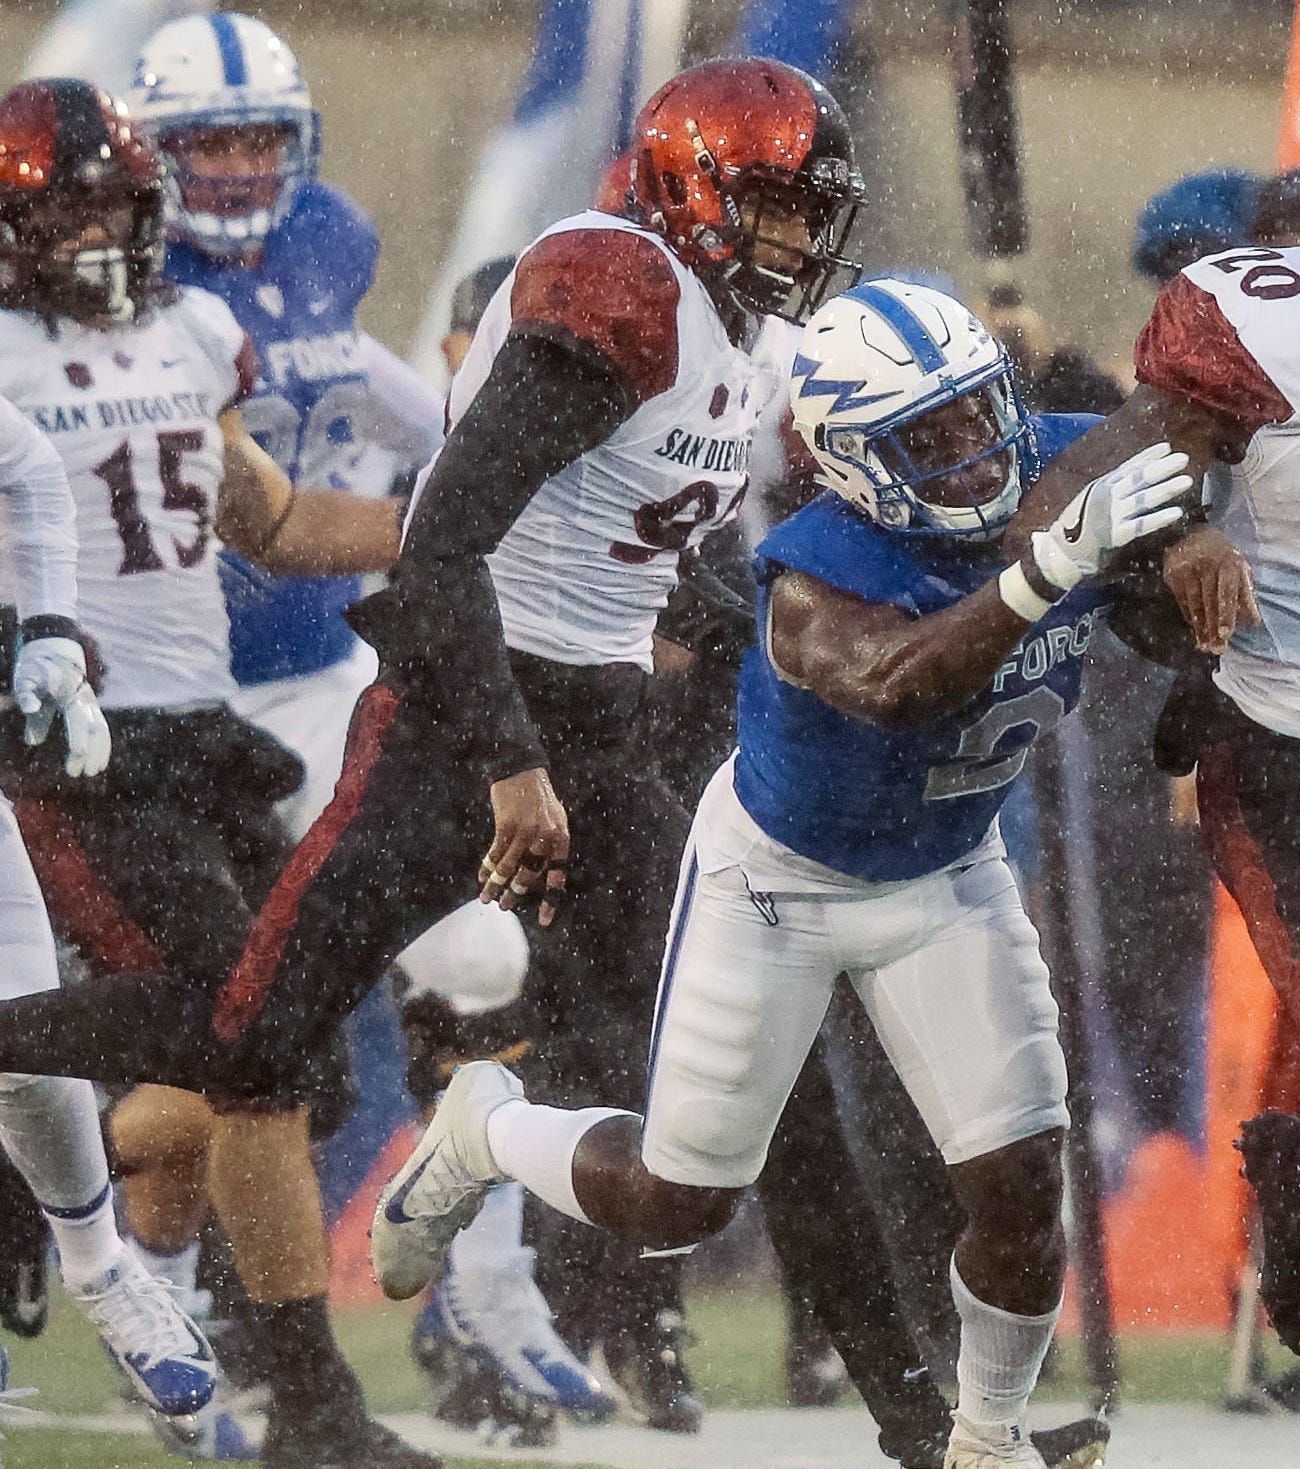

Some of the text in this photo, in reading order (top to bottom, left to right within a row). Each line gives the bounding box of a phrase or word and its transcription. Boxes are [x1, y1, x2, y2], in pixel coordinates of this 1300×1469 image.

[654, 428, 706, 468] SAN
[95, 427, 208, 577] 15
[609, 475, 750, 565] 9
[992, 604, 1113, 692] FORC
[922, 684, 1066, 804] 2
